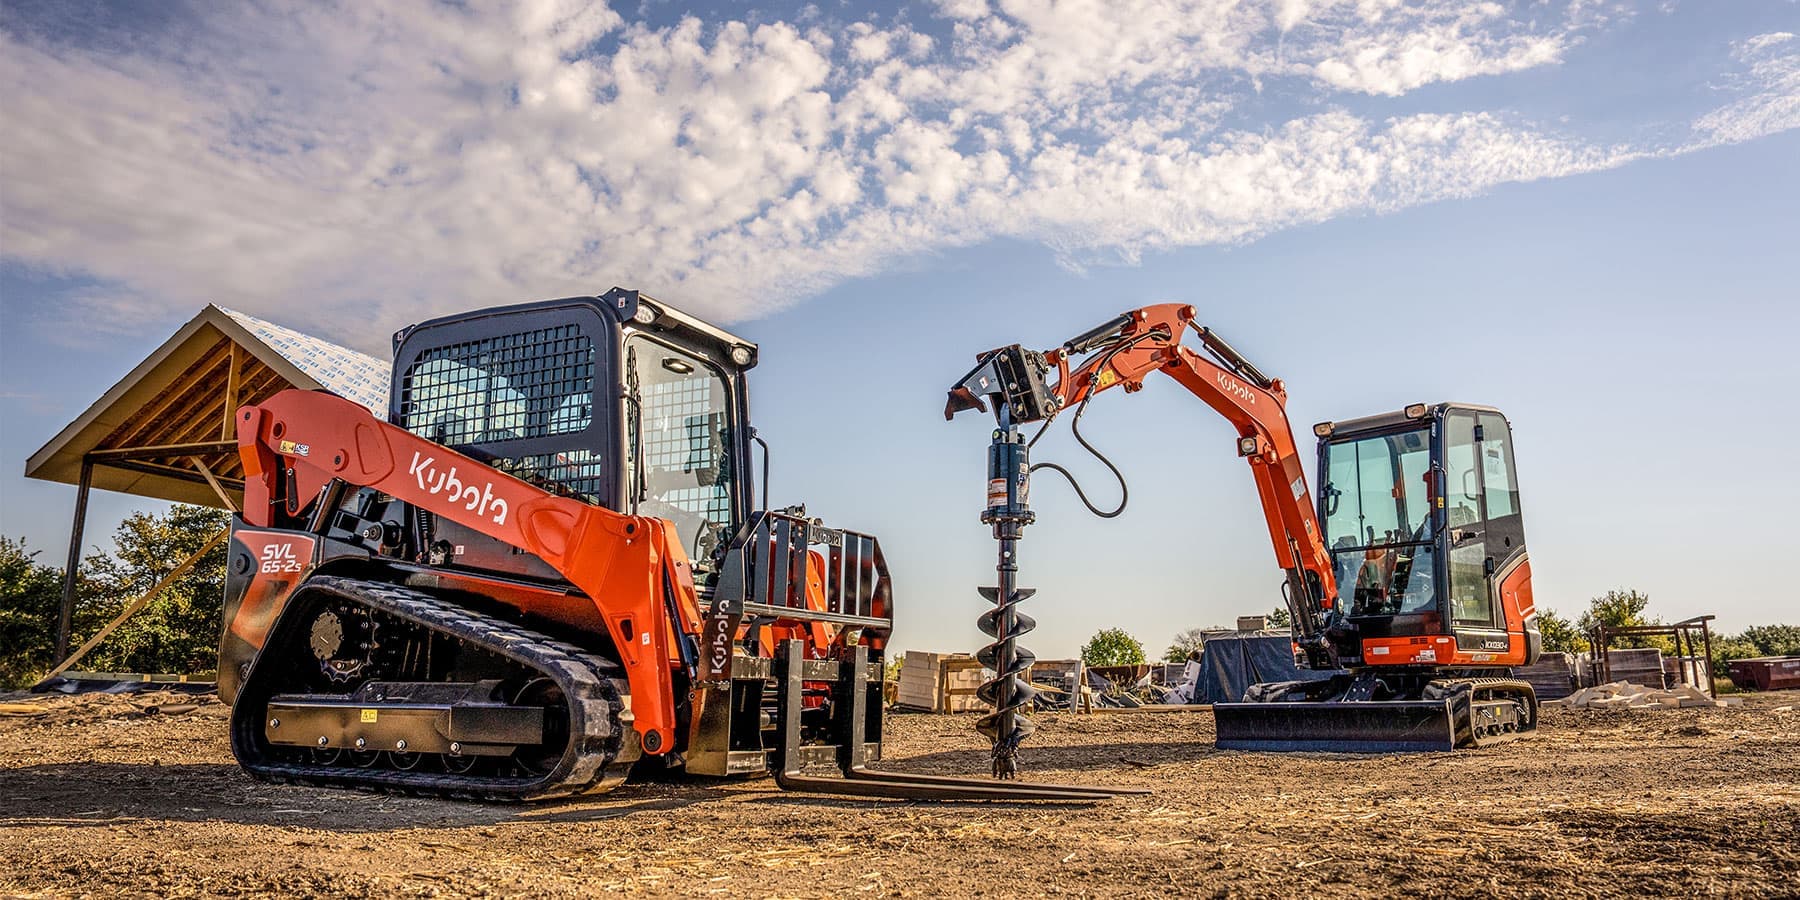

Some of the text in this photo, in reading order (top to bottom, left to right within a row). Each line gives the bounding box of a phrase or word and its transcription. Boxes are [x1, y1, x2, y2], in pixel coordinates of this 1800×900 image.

[1217, 371, 1255, 404] Kubota
[408, 450, 509, 526] Kubota
[261, 543, 296, 560] SVL
[711, 599, 730, 674] Kubota
